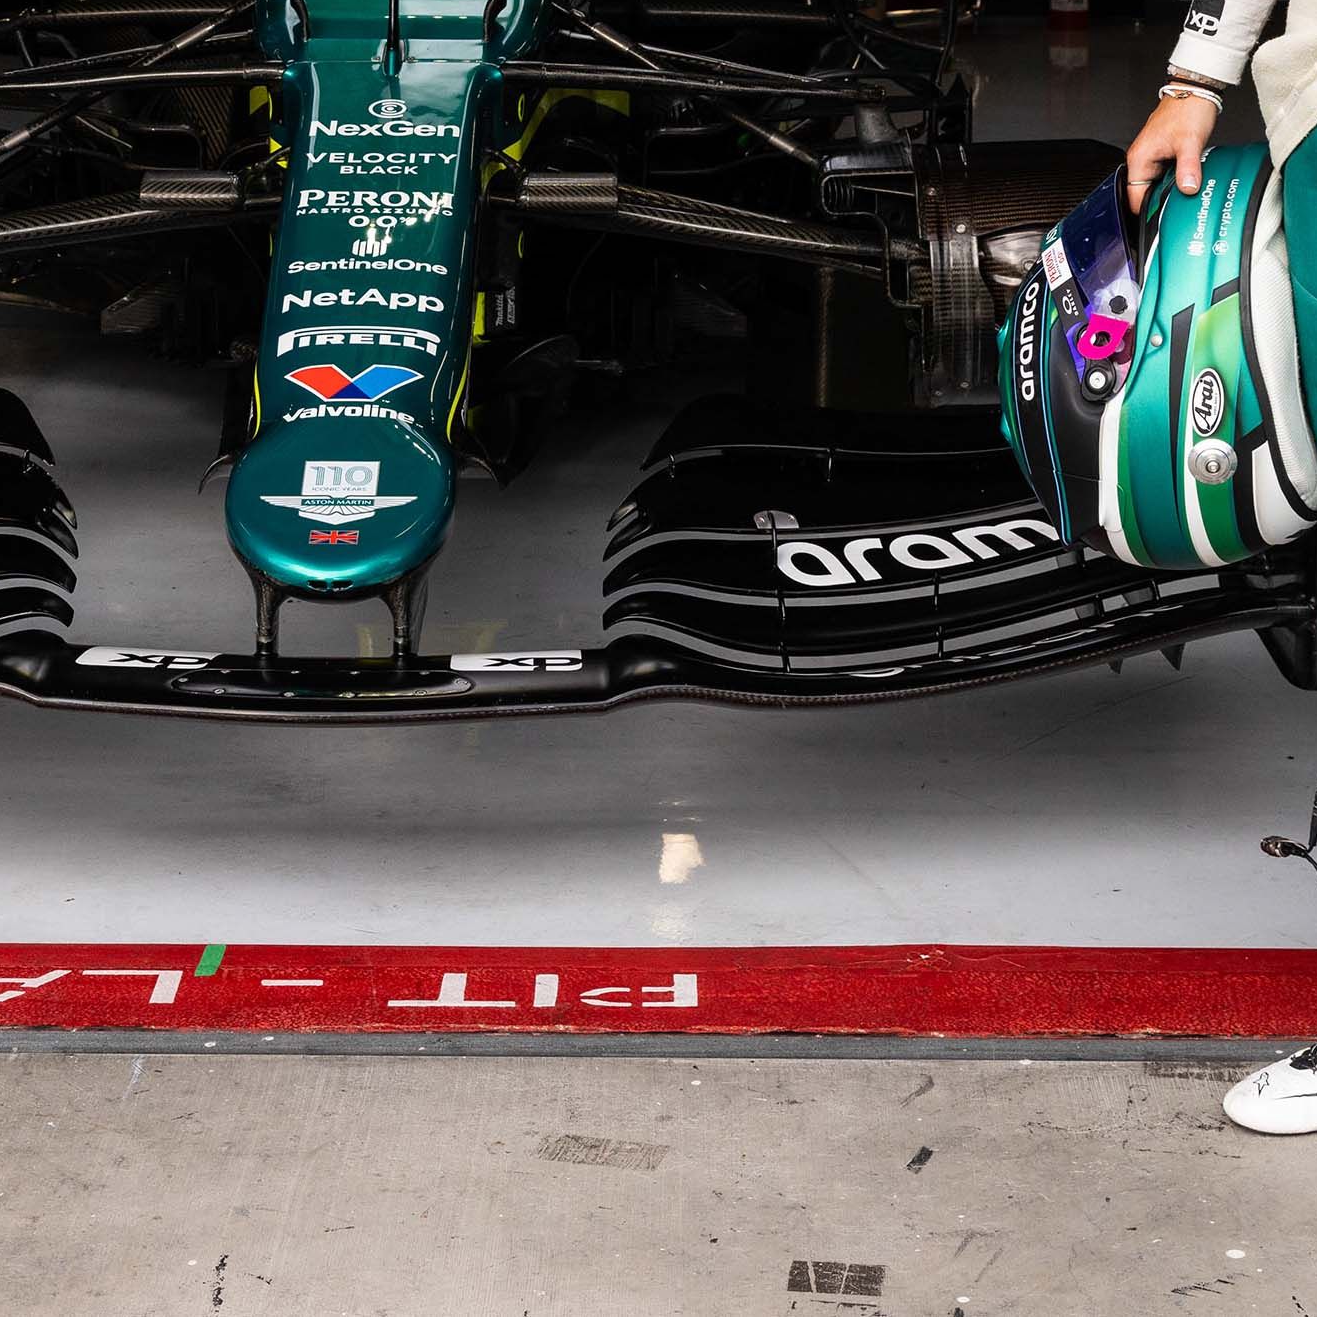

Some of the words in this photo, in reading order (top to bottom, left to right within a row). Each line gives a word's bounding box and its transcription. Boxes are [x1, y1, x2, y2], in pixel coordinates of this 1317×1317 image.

[308, 120, 460, 138] NexGen
[306, 152, 458, 165] VELOCITY
[339, 165, 418, 175] BLACK
[297, 189, 454, 210] PERONI
[1193, 178, 1217, 240] SentinelOne
[1217, 178, 1241, 238] crypto.com
[296, 206, 365, 217] NASTRO
[287, 258, 448, 275] SentinelOne
[282, 288, 444, 314] NetApp
[277, 325, 441, 357] PIRELLI
[1019, 282, 1040, 403] aramco
[283, 404, 415, 425] Valvoline
[1194, 379, 1214, 431] Arai
[310, 466, 373, 486] 110
[776, 518, 1062, 586] aram
